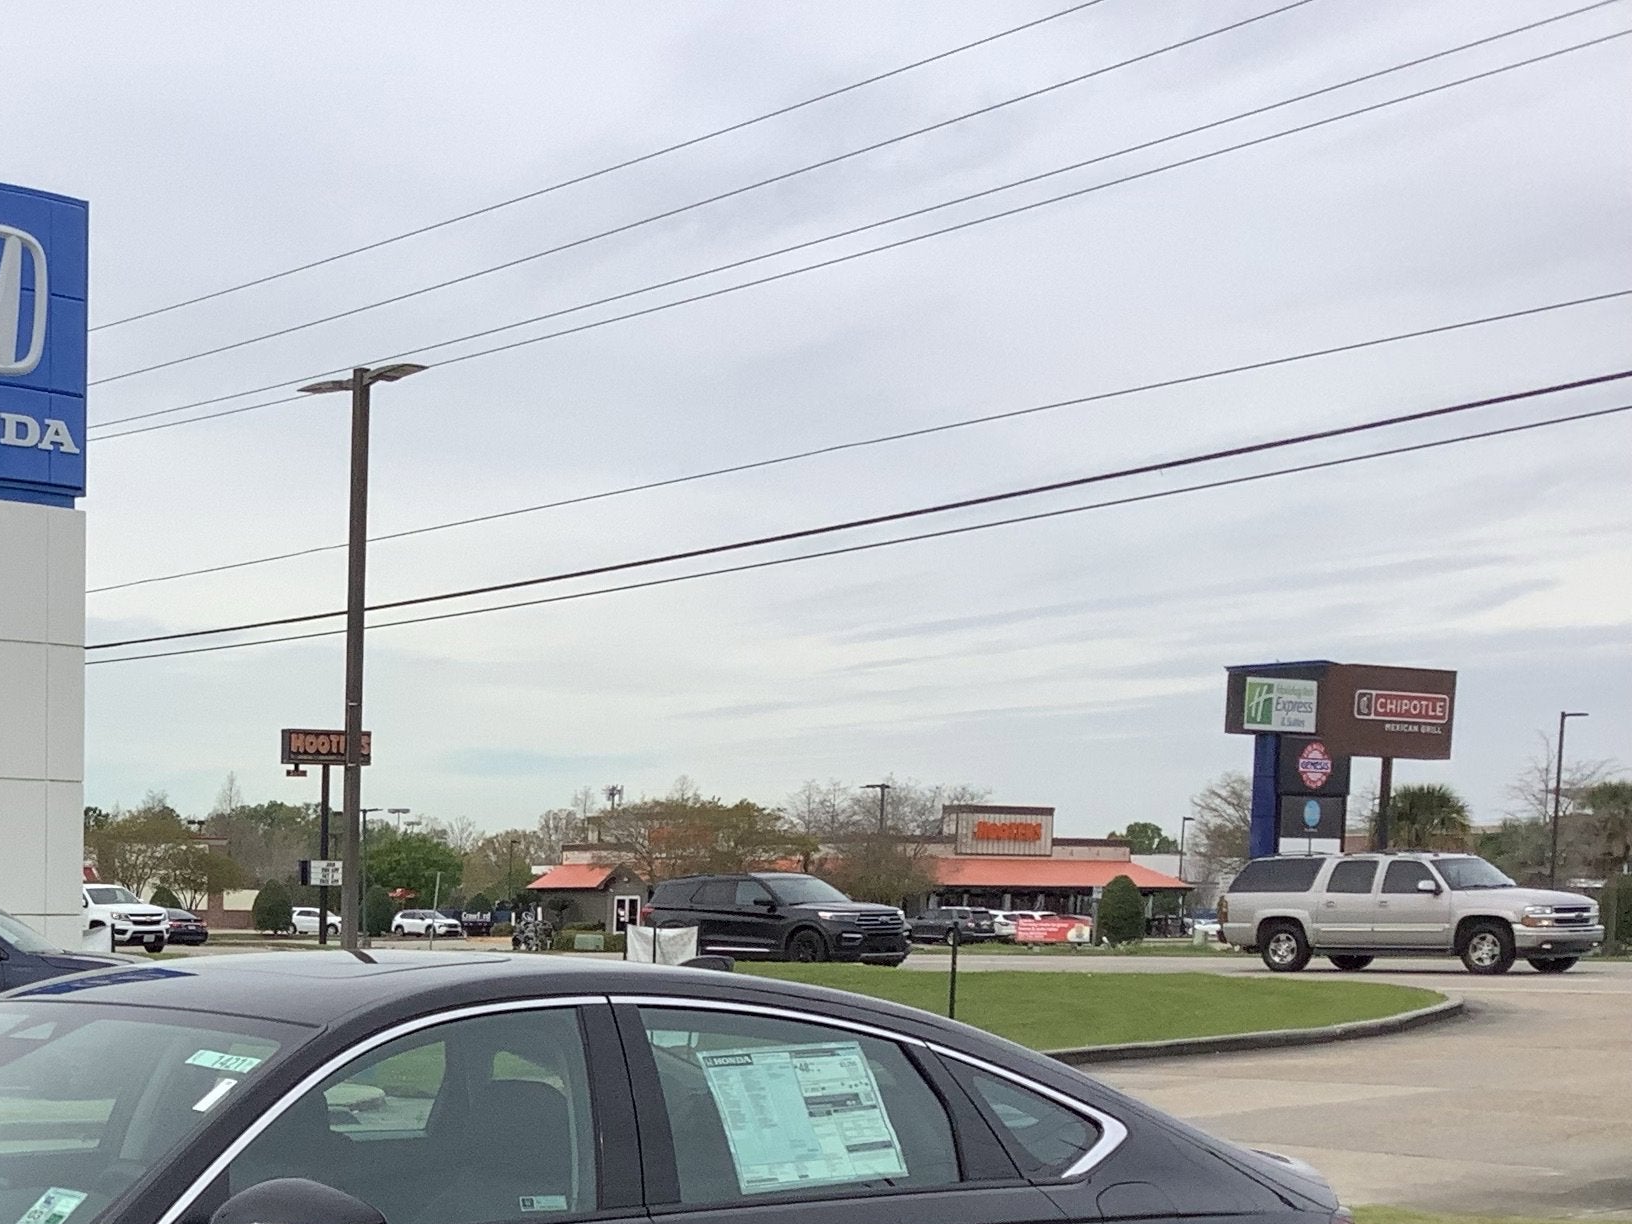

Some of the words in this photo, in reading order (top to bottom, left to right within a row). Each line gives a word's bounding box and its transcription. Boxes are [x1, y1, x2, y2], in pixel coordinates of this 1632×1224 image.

[1275, 696, 1313, 715] Express
[1376, 698, 1445, 716] CHIPOTLE
[1384, 723, 1419, 733] MEXICAN
[290, 733, 370, 754] HOOTS
[713, 1055, 752, 1066] HONDA
